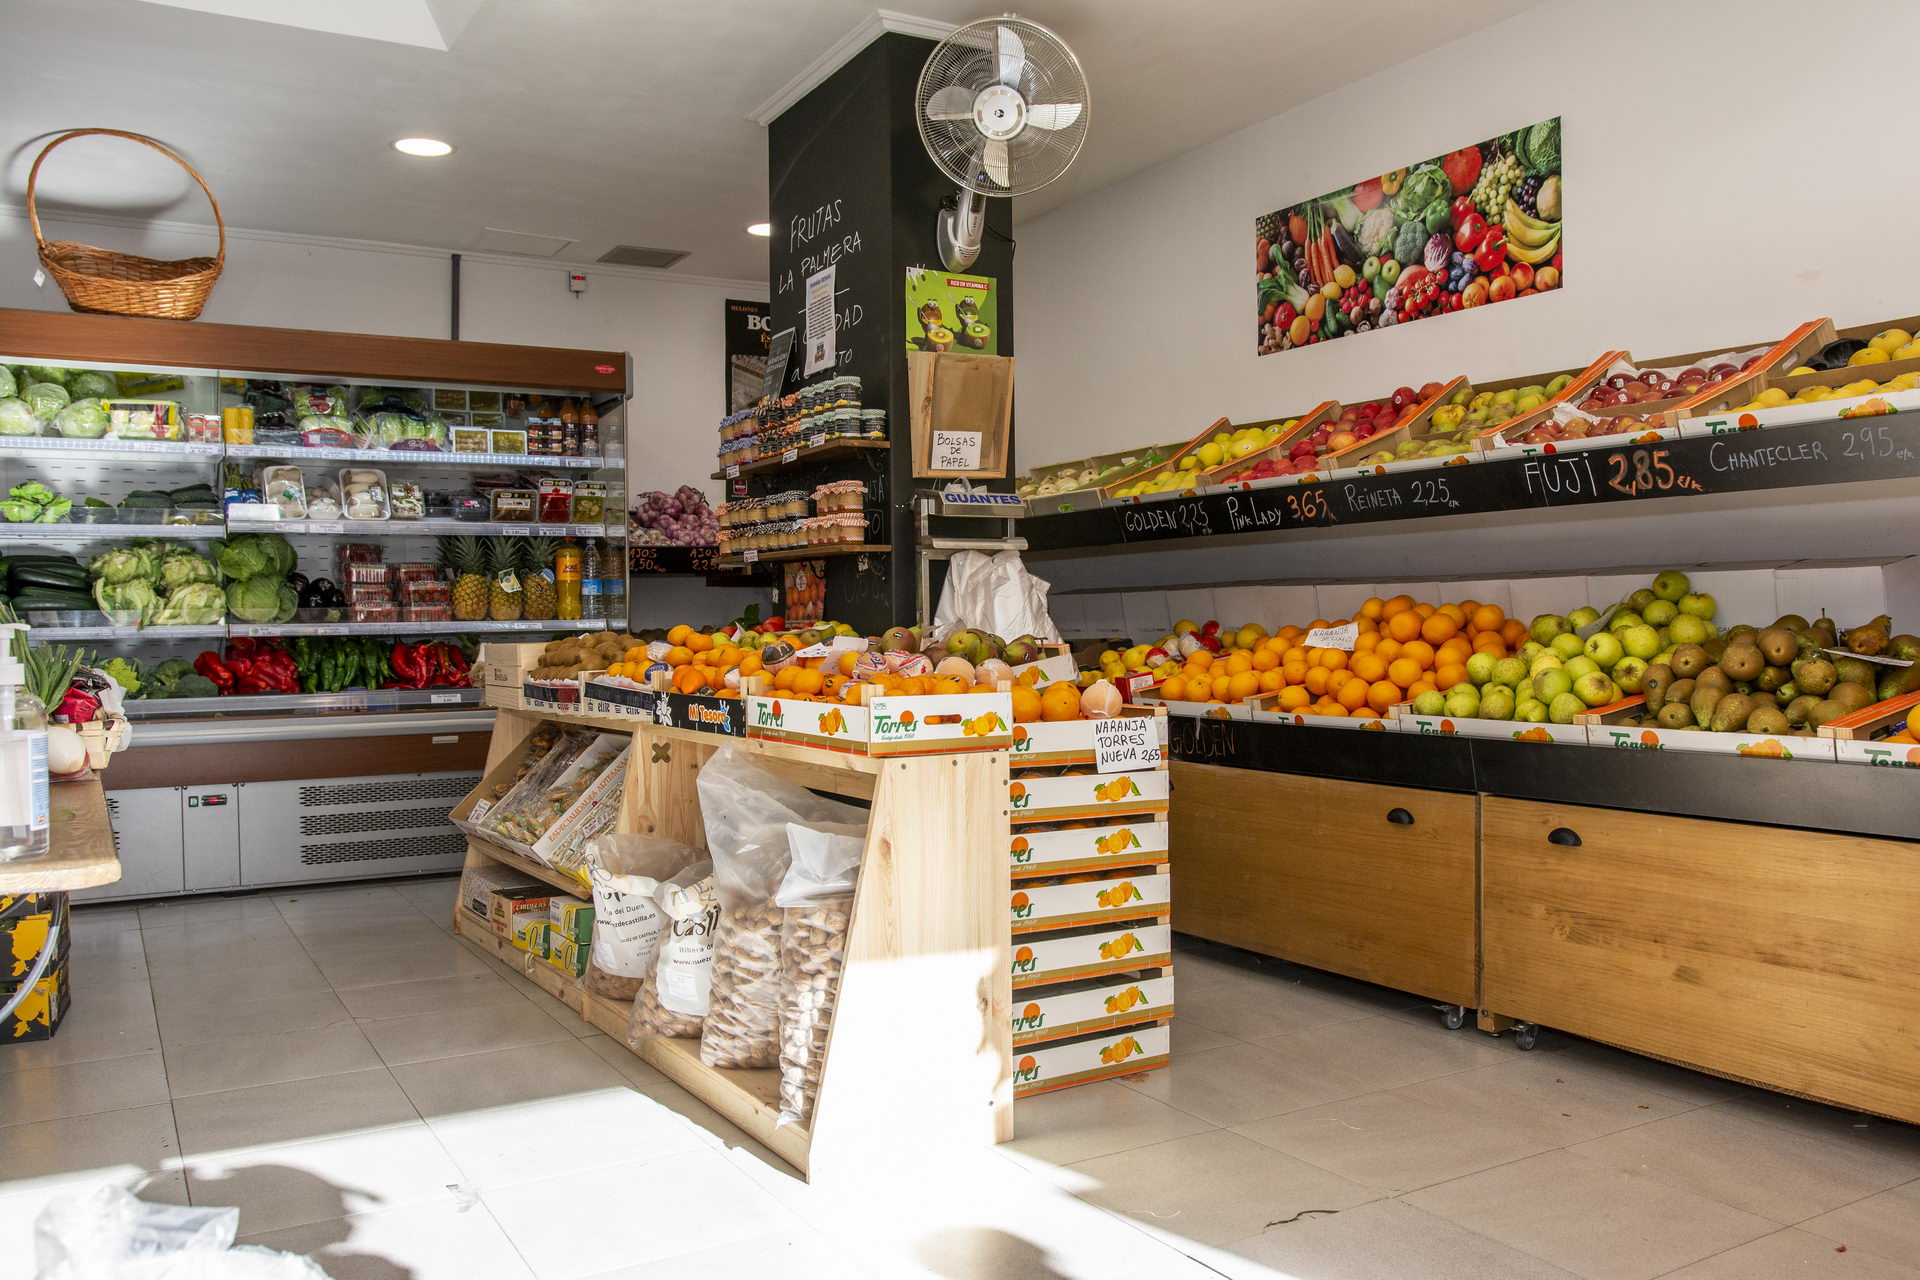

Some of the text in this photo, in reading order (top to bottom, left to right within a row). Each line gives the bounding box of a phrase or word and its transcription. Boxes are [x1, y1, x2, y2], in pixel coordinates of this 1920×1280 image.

[790, 199, 842, 254] FRUTAS
[778, 230, 862, 295] LA PALMERA
[937, 432, 976, 446] BOLSAS
[1709, 441, 1828, 472] CHANTECLER
[1842, 426, 1894, 461] 2,95
[940, 456, 970, 468] PAPEL
[1608, 450, 1674, 496] 2,85
[944, 493, 1022, 504] GUANTES
[1411, 478, 1450, 506] 2,25
[1287, 490, 1327, 521] 3,65
[1125, 509, 1177, 532] GOLDEN
[1179, 501, 1208, 535] 2,25
[688, 703, 727, 724] Mi Tesoro
[757, 702, 784, 728] Torres
[874, 715, 918, 734] Torres
[1096, 720, 1147, 735] NARANJA
[1098, 734, 1145, 748] TORRES
[1101, 748, 1160, 765] NUEVA 2,65
[615, 906, 624, 915] del
[627, 904, 645, 912] Duero
[679, 944, 704, 953] Ribera
